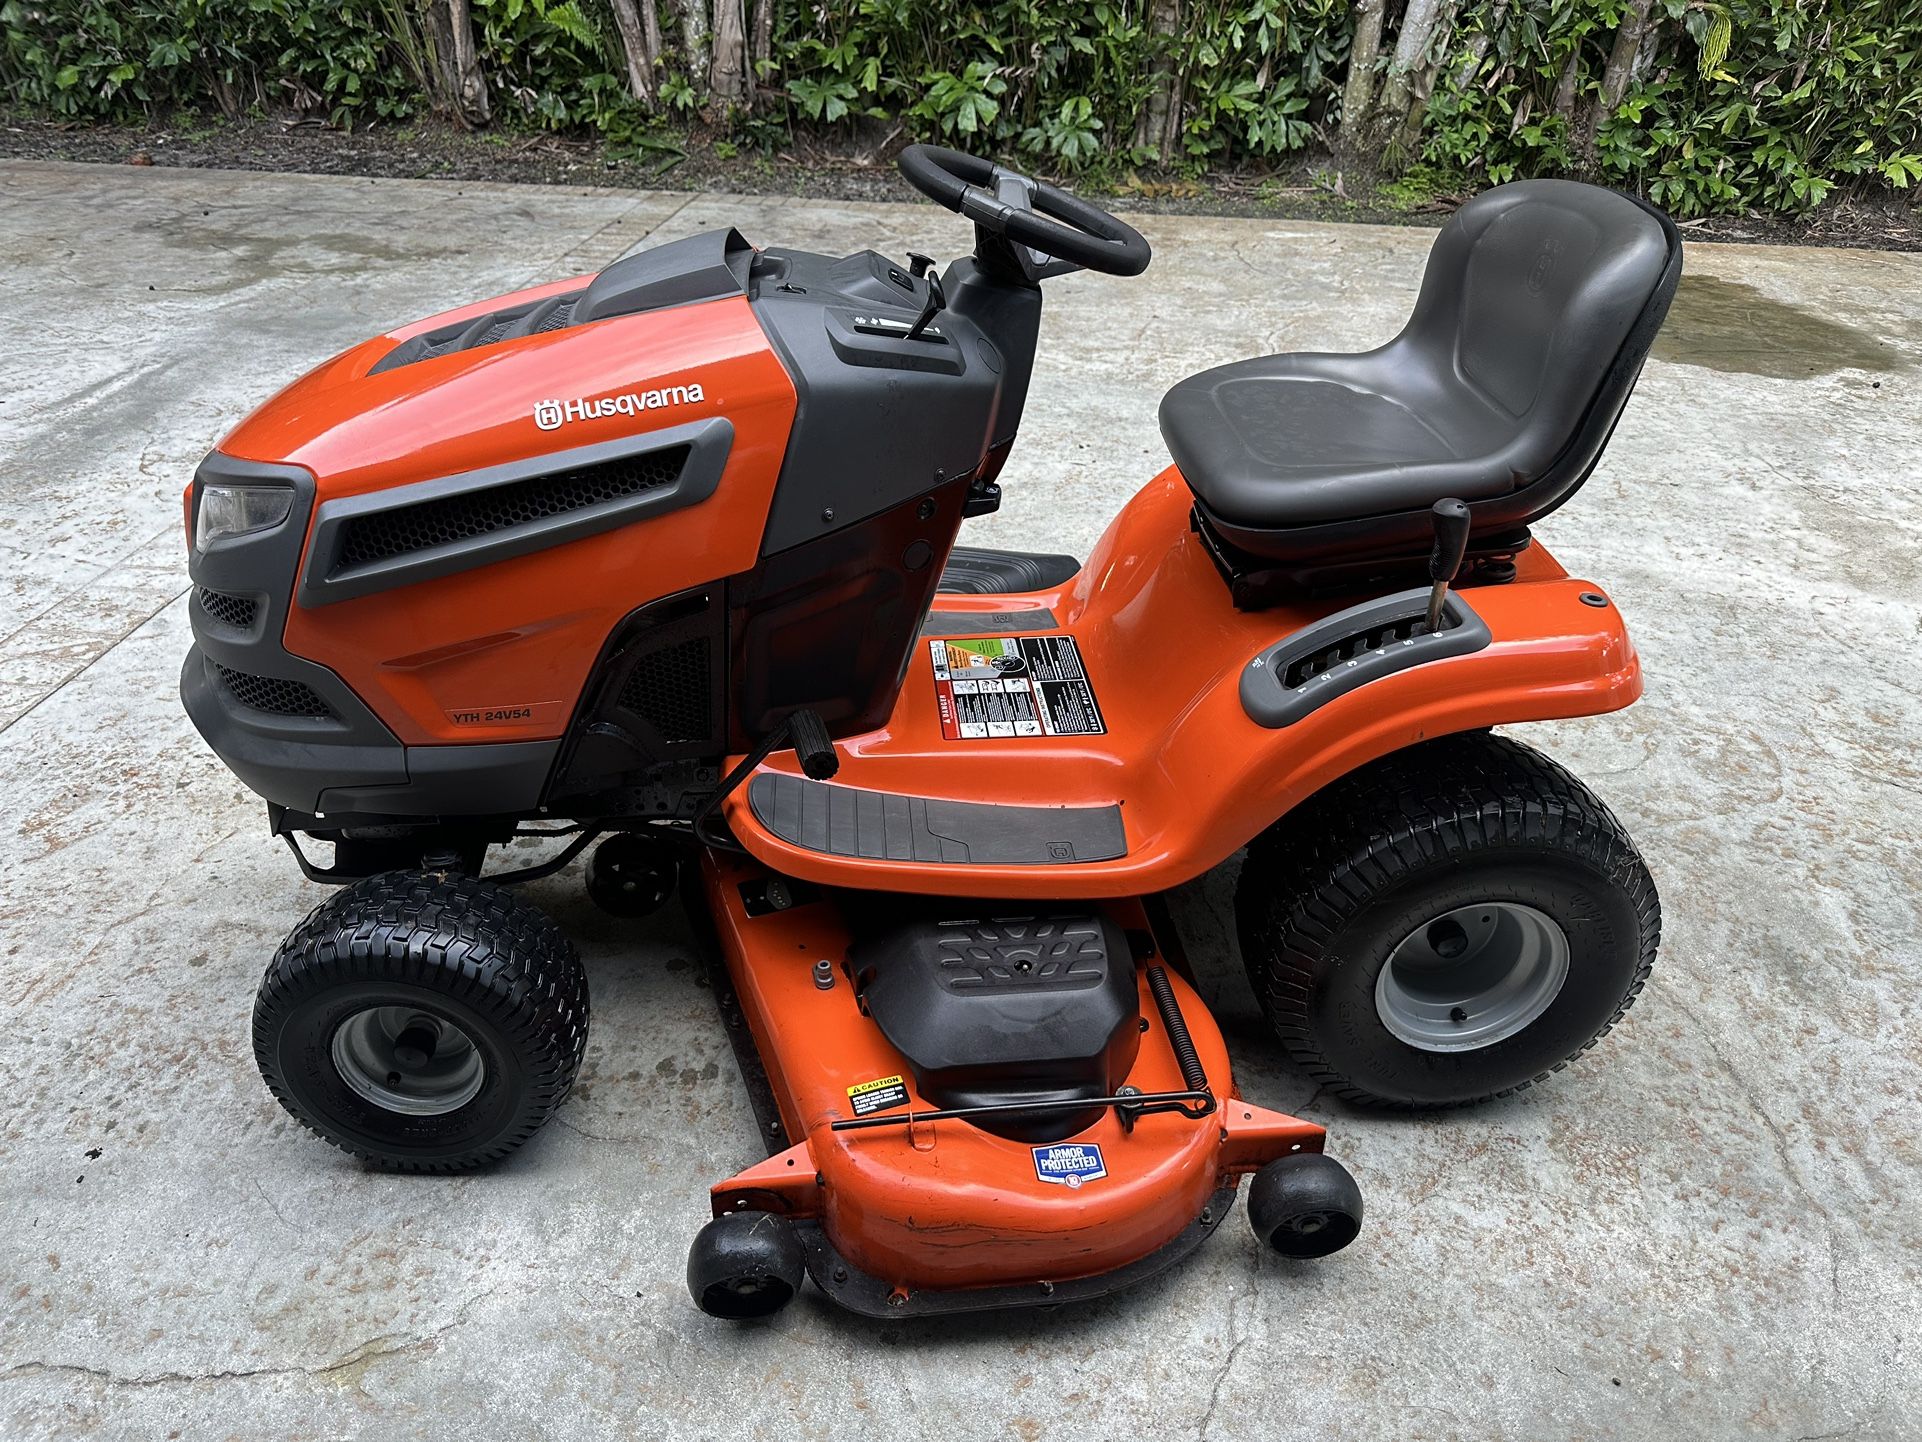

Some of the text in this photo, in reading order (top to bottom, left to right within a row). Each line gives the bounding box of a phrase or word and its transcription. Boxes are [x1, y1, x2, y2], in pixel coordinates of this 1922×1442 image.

[565, 382, 704, 423] Husqvarna
[940, 694, 950, 719] DANGER
[453, 708, 532, 724] YTH 24V54
[861, 1076, 900, 1091] CAUTION
[1048, 1147, 1085, 1160] ARMOR
[1040, 1155, 1098, 1171] PROTECTED
